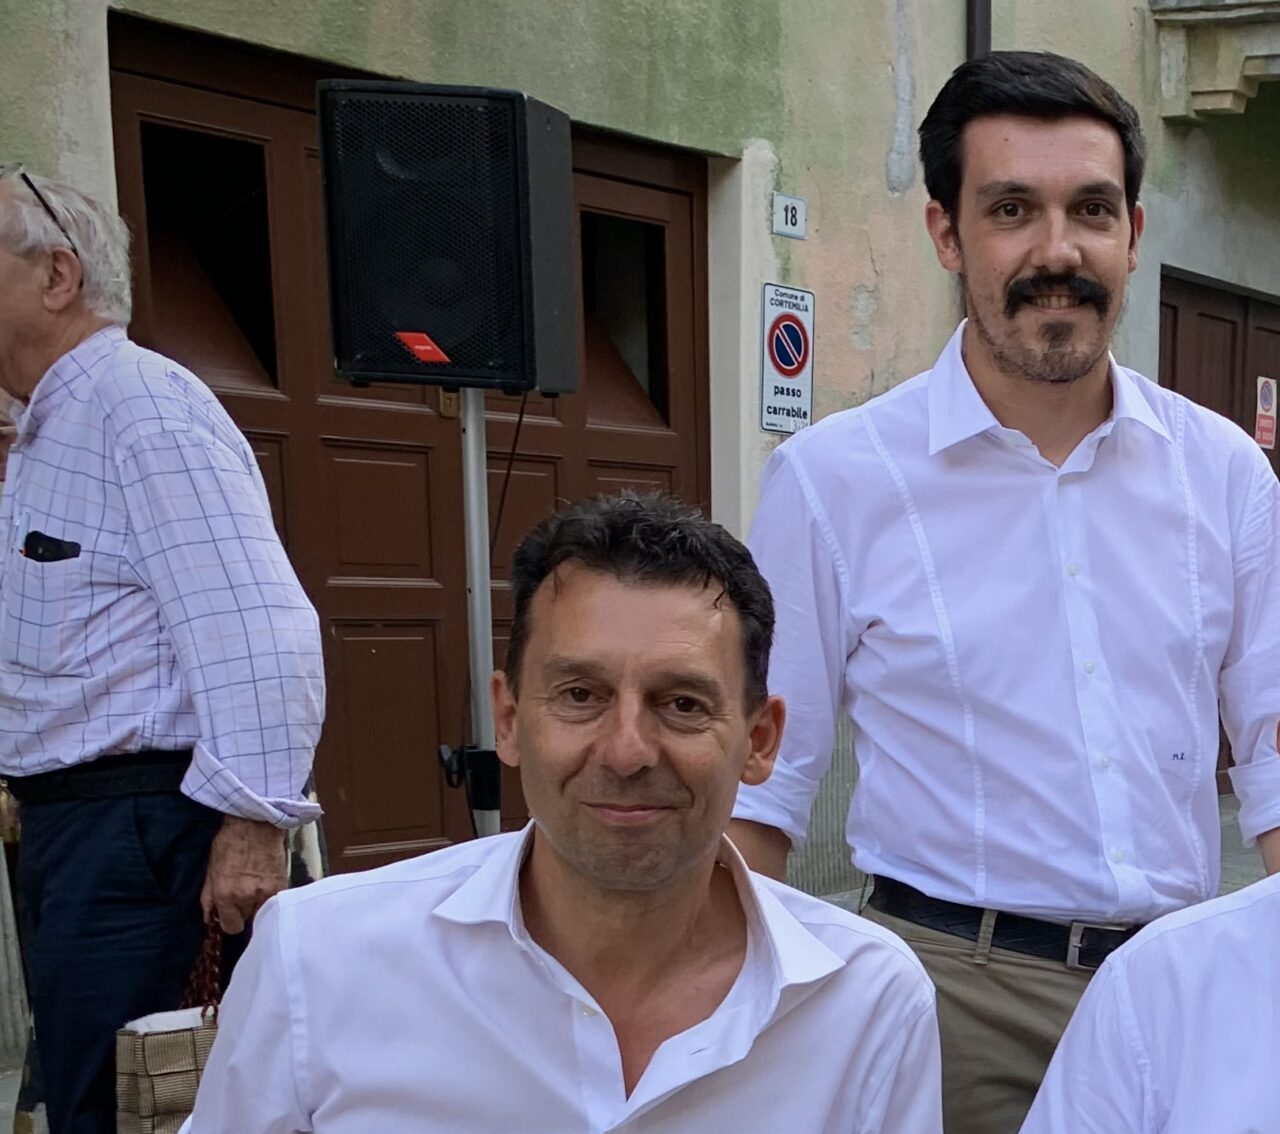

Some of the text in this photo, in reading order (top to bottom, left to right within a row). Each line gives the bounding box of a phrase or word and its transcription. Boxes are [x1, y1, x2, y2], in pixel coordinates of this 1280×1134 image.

[784, 204, 798, 227] 18
[774, 288, 799, 301] Comune
[774, 385, 802, 398] passo
[766, 405, 808, 419] carrabile
